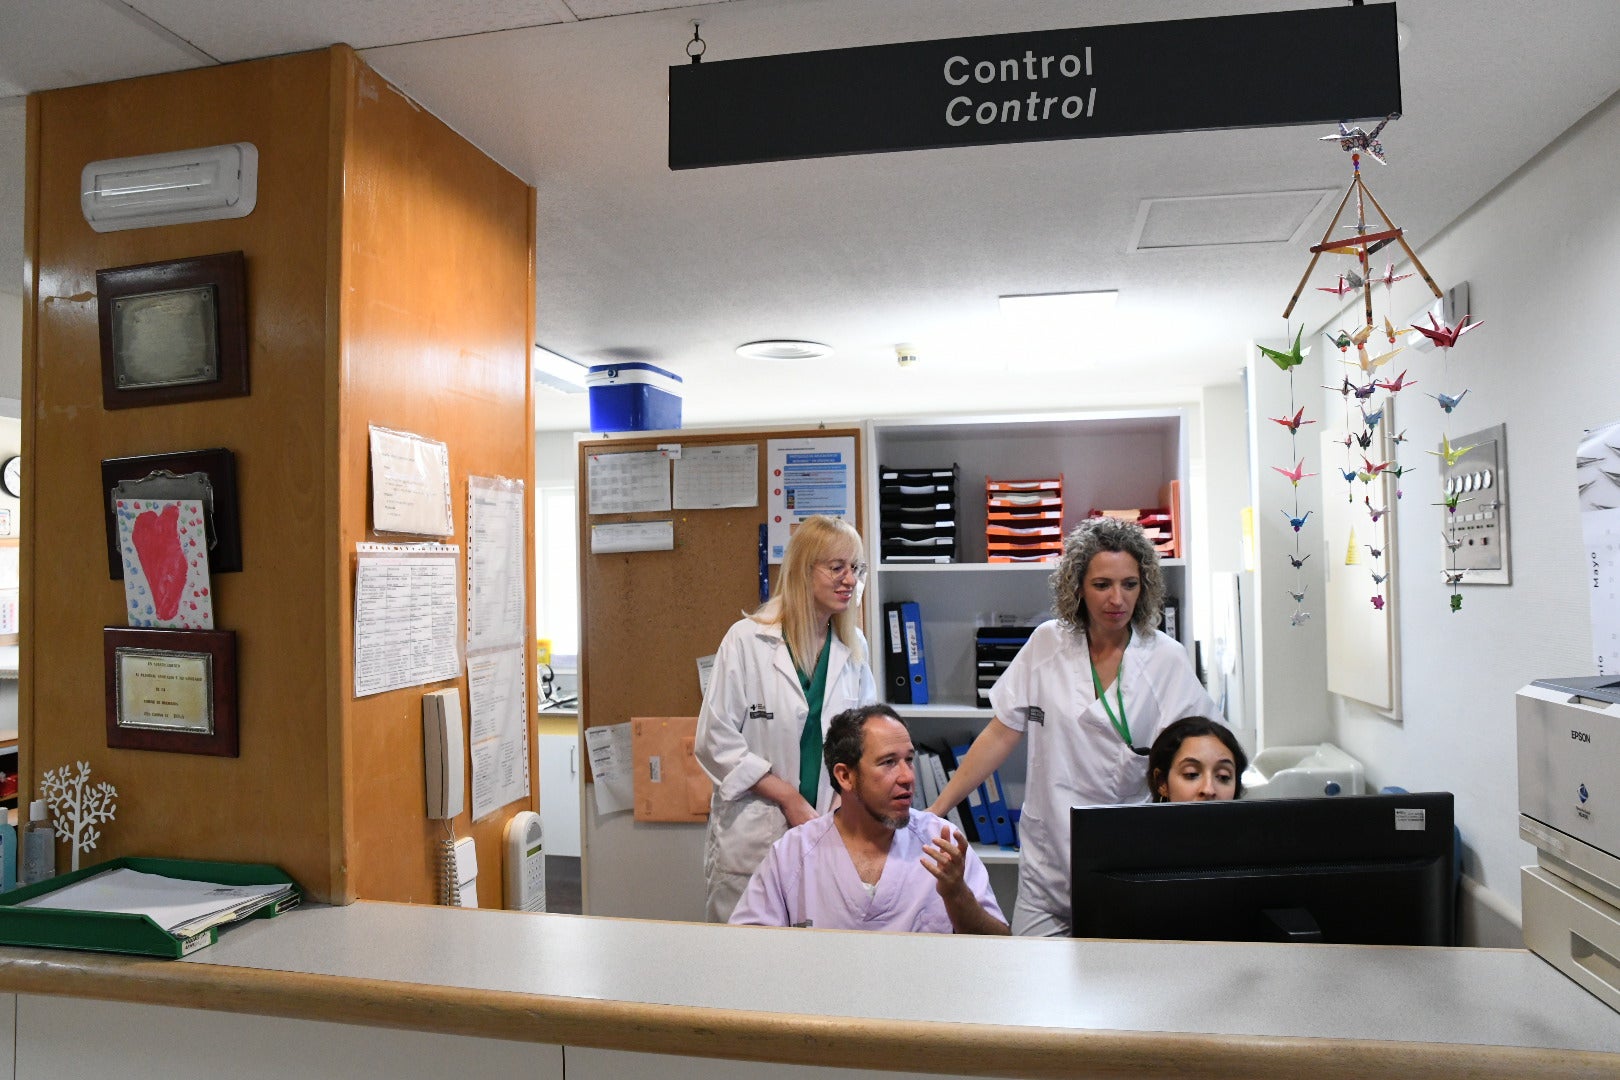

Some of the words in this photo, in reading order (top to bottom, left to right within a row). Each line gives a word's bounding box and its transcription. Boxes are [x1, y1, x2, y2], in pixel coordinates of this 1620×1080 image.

[943, 46, 1093, 86] Control
[945, 87, 1097, 127] Control
[1591, 552, 1600, 588] Mayo
[1571, 730, 1591, 744] EPSON
